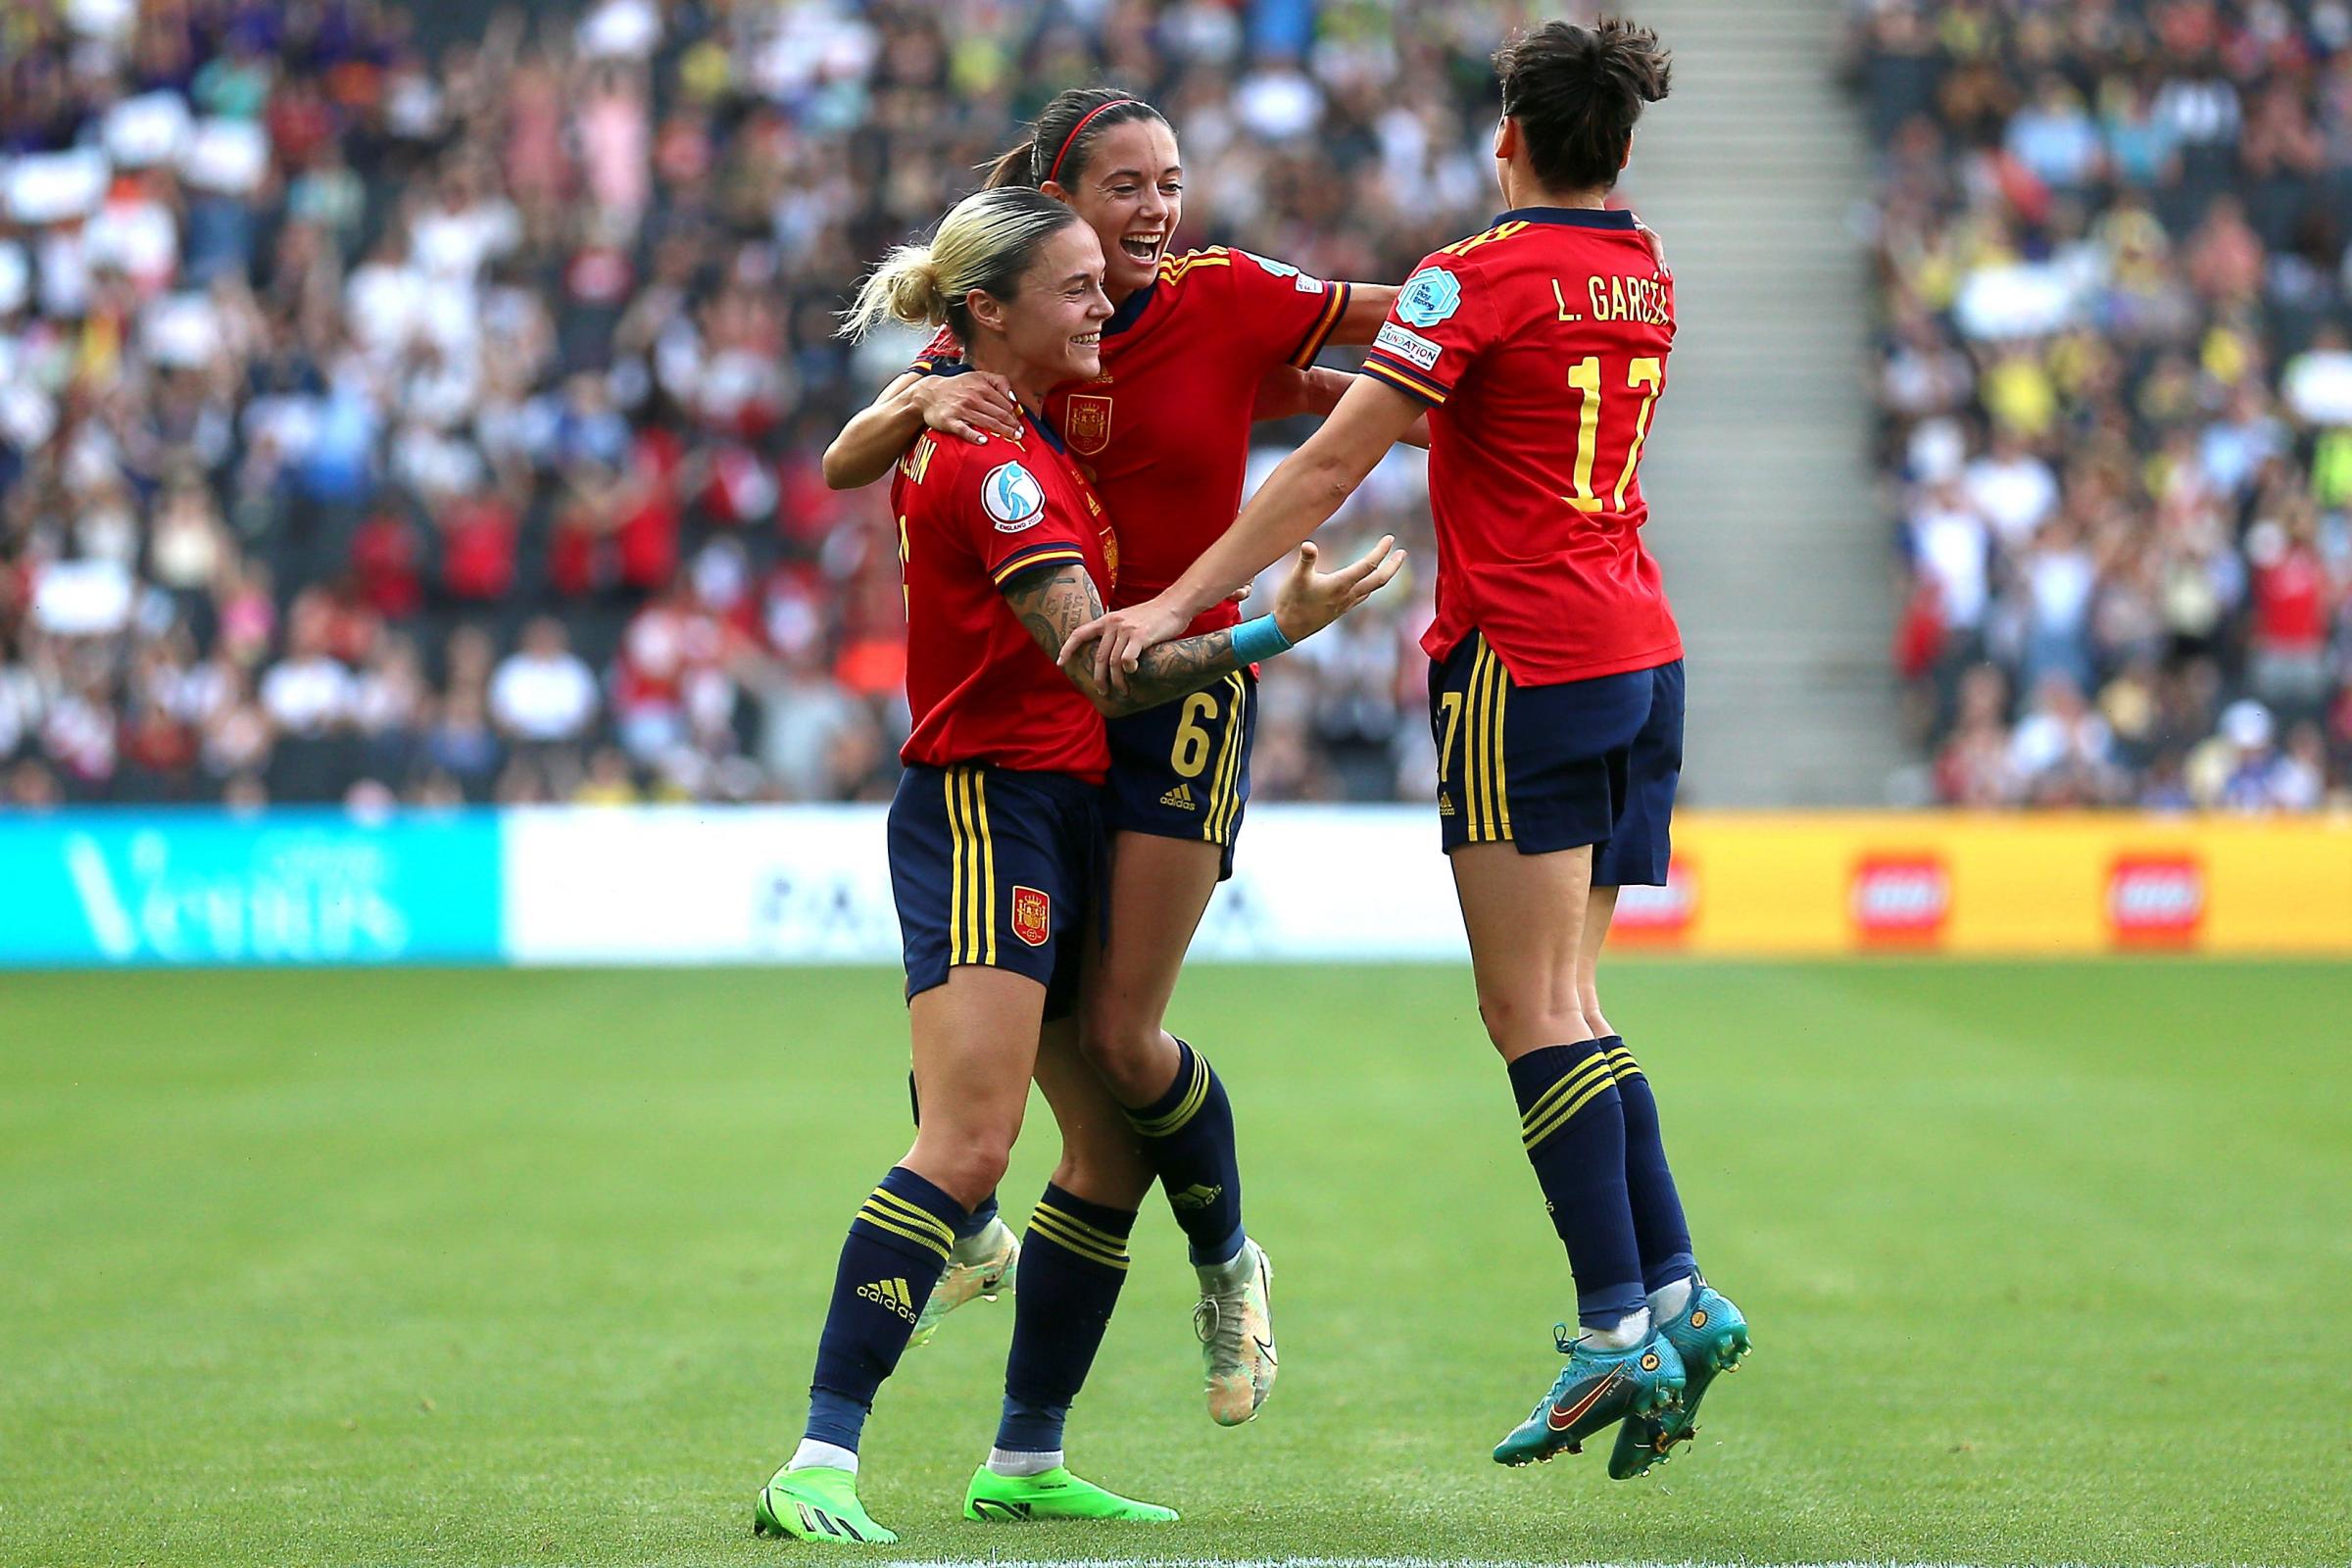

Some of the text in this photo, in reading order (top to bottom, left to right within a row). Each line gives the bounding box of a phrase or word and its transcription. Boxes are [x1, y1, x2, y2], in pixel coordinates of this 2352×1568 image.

[1551, 278, 1582, 321] L.
[1379, 329, 1437, 362] OUNDATION
[1560, 356, 1662, 514] 17
[1171, 691, 1218, 778] 6
[1159, 796, 1197, 811] adidas
[856, 1286, 917, 1325] adidas
